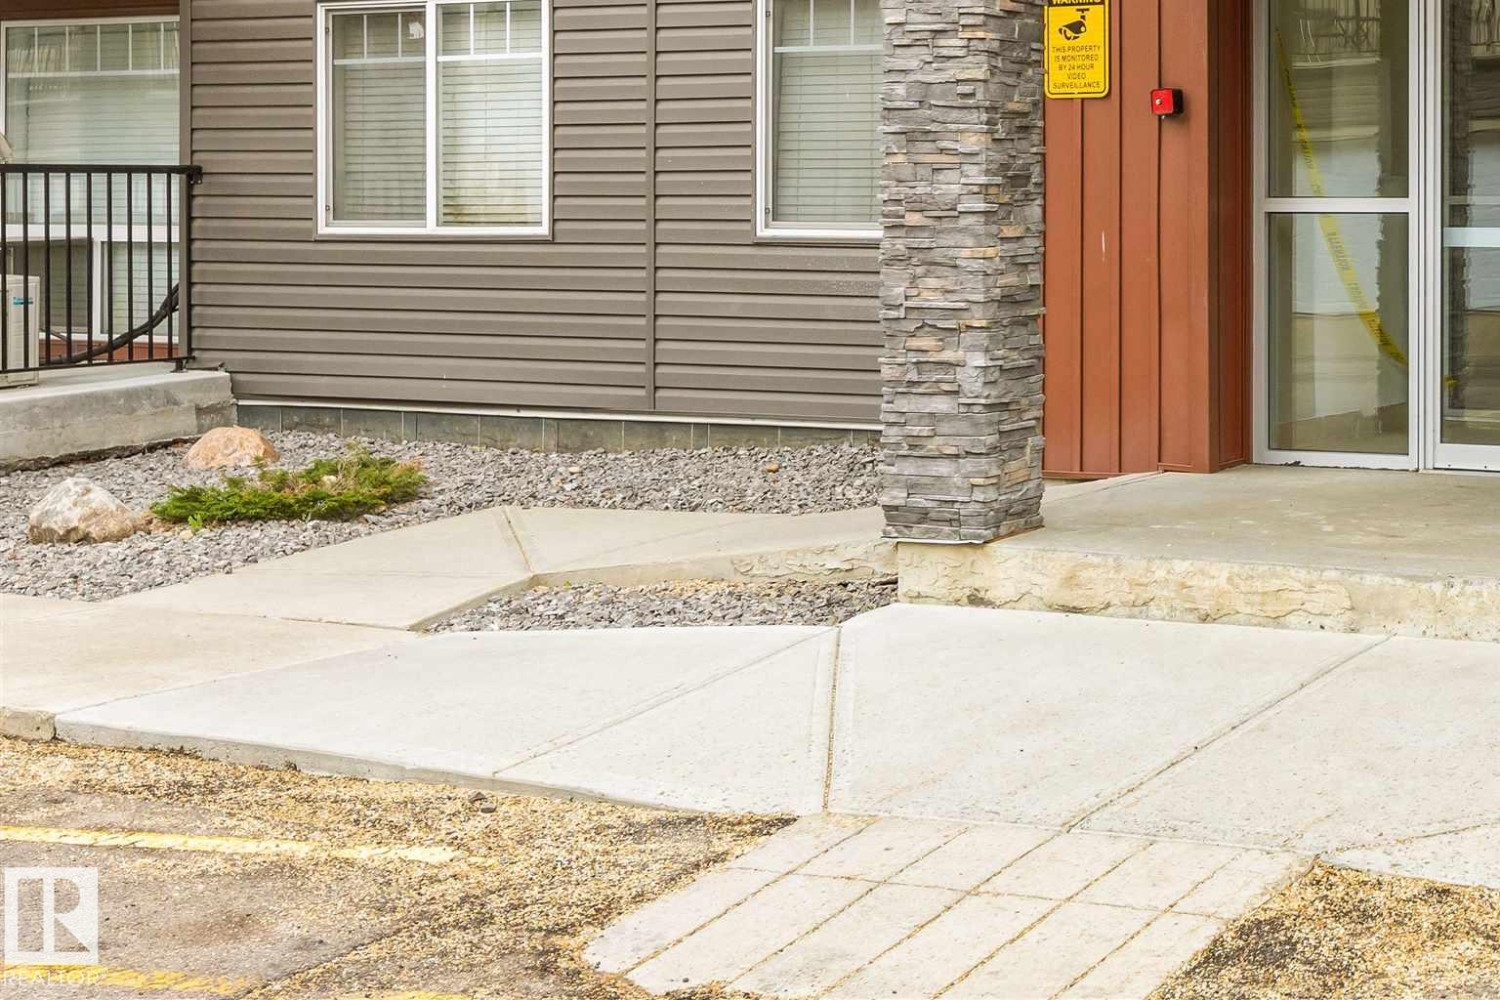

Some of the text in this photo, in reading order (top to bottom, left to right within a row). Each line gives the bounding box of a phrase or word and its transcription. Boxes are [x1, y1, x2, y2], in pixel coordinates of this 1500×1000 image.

[1067, 45, 1101, 53] PROPERTY
[1061, 54, 1099, 62] MONITORED
[1076, 63, 1095, 71] HOUR
[1053, 81, 1100, 89] SURVEILLANCE
